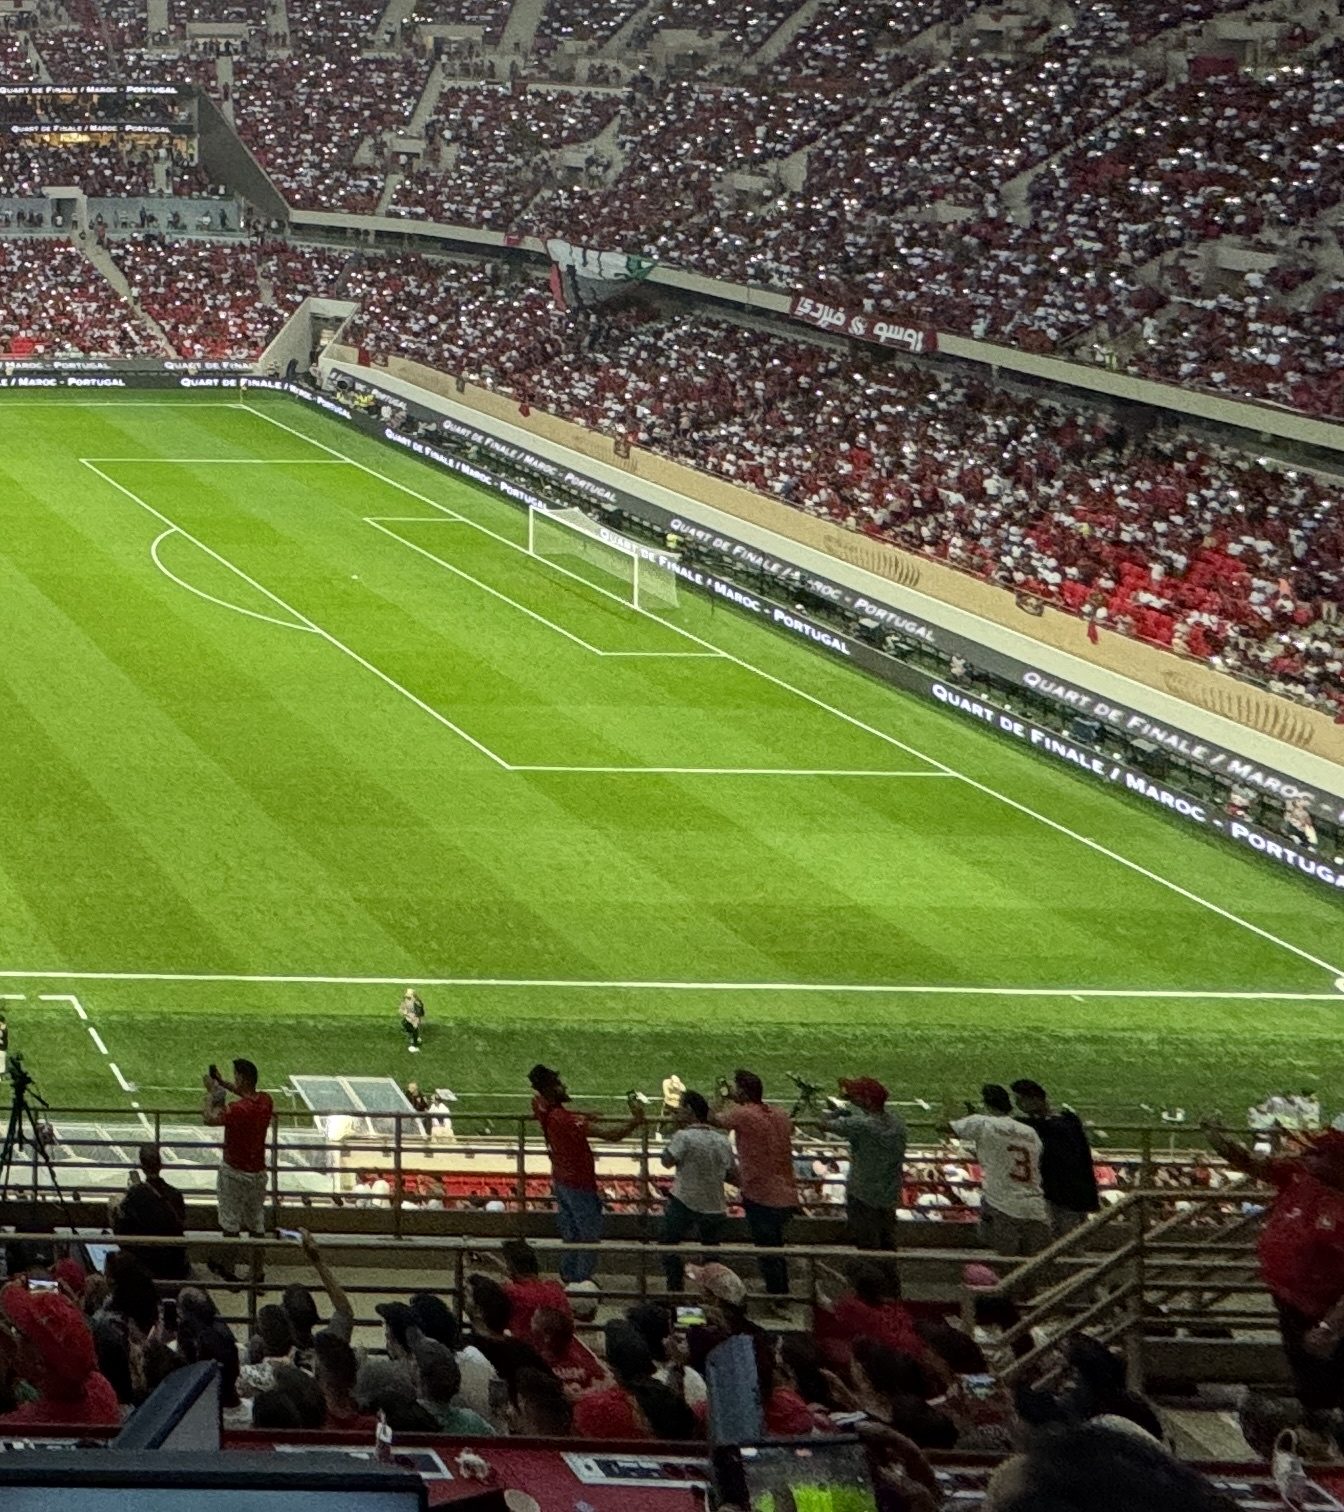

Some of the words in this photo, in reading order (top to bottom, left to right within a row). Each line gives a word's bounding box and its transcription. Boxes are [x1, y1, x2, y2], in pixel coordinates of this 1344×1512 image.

[18, 378, 57, 386] MAROC
[69, 378, 126, 386] PORTUGAL
[640, 548, 658, 562] DE
[658, 554, 703, 585] FINALE
[713, 581, 760, 612] MAROC
[773, 608, 850, 655] PORTUGAL
[932, 683, 994, 723] QUART
[999, 715, 1025, 737] DE
[1027, 727, 1104, 775] FINALE
[1125, 773, 1206, 822] MAROC
[1022, 671, 1092, 707] QUART
[1094, 702, 1123, 722] DE
[1126, 716, 1210, 760] FINALE
[1007, 1145, 1032, 1182] 3
